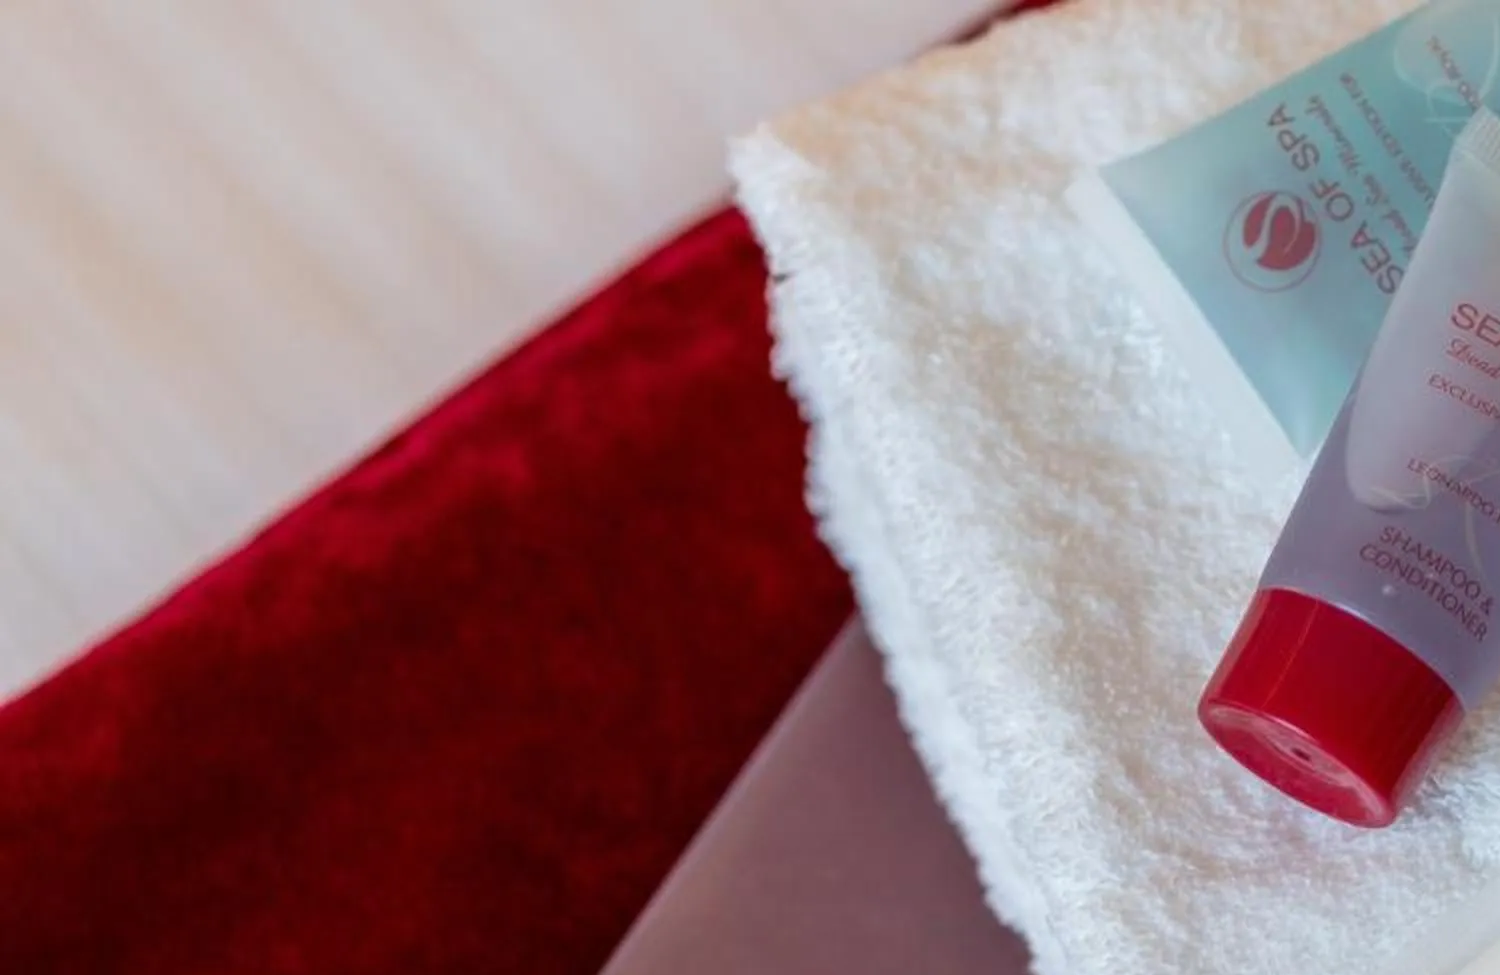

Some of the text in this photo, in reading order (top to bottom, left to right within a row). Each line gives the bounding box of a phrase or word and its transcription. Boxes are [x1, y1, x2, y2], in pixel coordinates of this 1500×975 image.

[1304, 95, 1362, 176] Minerals
[1267, 103, 1404, 294] SEA OF SPA
[1406, 457, 1496, 517] LEONARDO
[1359, 543, 1488, 642] CONDITIONER
[1379, 526, 1494, 616] SHAMPOO &
